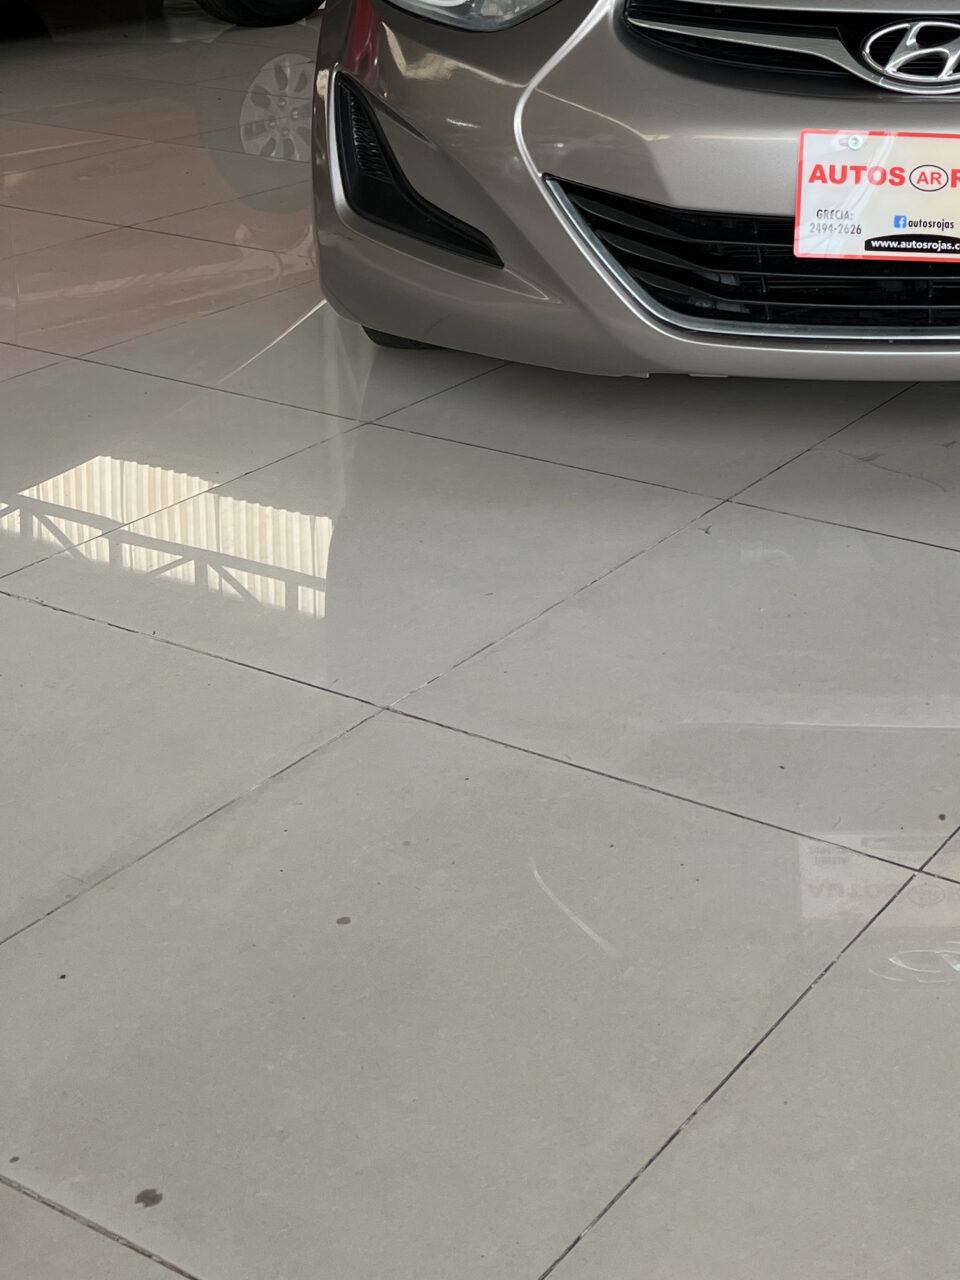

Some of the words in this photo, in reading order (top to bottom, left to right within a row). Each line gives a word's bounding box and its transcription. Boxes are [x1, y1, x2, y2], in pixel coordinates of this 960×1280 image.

[808, 163, 906, 187] AUTOS
[916, 170, 942, 186] AR
[809, 222, 862, 235] 2494-2626
[907, 218, 955, 231] autosrojas
